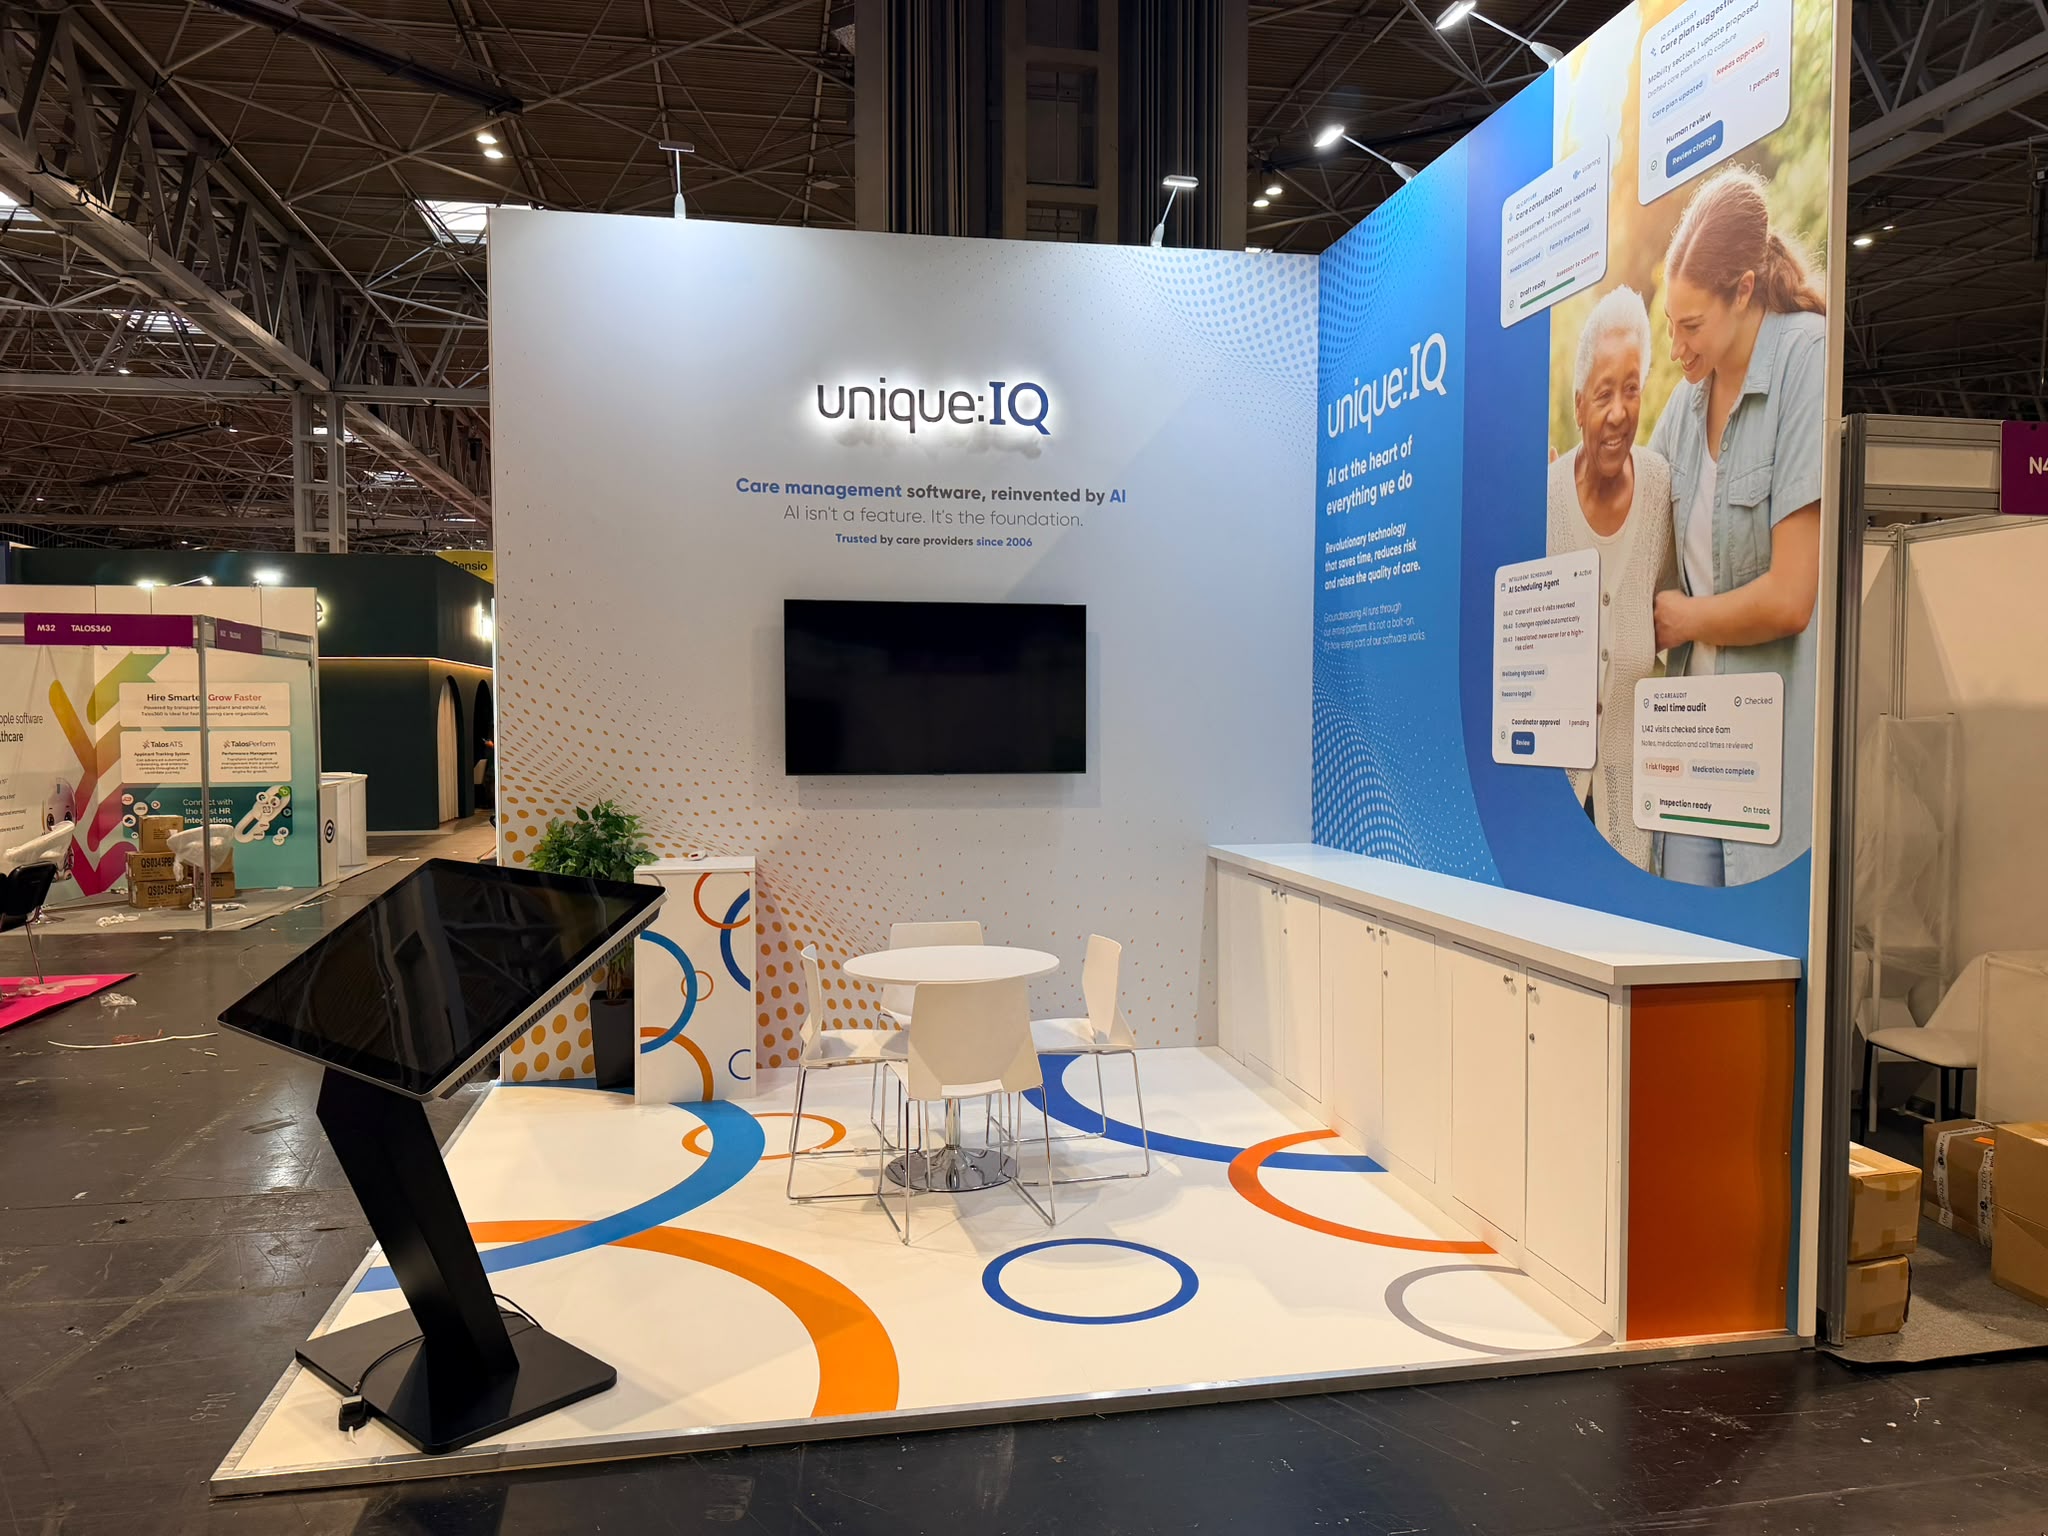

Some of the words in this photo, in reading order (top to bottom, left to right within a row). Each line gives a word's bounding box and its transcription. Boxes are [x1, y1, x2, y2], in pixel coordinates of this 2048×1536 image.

[1648, 64, 1670, 84] Mobility
[1702, 25, 1724, 48] update
[1726, 0, 1758, 31] proposed
[1660, 36, 1678, 54] Care
[1678, 25, 1695, 46] plan
[1680, 65, 1692, 80] plan
[1693, 54, 1706, 68] from
[1714, 33, 1737, 54] capture
[1716, 60, 1735, 76] Needs
[1736, 38, 1765, 65] approval
[1753, 68, 1780, 91] pending
[1652, 106, 1664, 119] Care
[1666, 98, 1678, 113] plan
[1679, 80, 1703, 101] updated
[1666, 126, 1688, 144] Human
[1690, 111, 1712, 130] review
[1672, 150, 1692, 166] Review
[1693, 134, 1716, 152] change
[1516, 207, 1528, 220] Care
[1529, 186, 1563, 215] consultation
[1576, 224, 1590, 237] noted
[1523, 252, 1540, 269] captured
[1519, 287, 1532, 298] Draft
[1532, 280, 1546, 293] ready
[1328, 332, 1447, 438] unique:IQ
[817, 377, 1051, 435] unique:IQ
[1326, 468, 1336, 487] AI
[1338, 465, 1348, 483] at
[1351, 458, 1366, 478] the
[1369, 443, 1398, 470] heart
[1401, 434, 1413, 458] of
[736, 478, 780, 493] Care
[785, 484, 902, 499] management
[907, 485, 986, 502] software,
[992, 487, 1080, 502] reinvented
[1085, 489, 1105, 505] by
[1110, 490, 1126, 503] AI
[1326, 484, 1377, 516] everything
[1379, 478, 1395, 498] we
[1398, 470, 1413, 491] do
[784, 505, 799, 520] AI
[805, 506, 838, 521] isn't
[843, 510, 854, 521] a
[860, 507, 926, 523] feature.
[932, 510, 952, 524] It's
[958, 510, 985, 524] the
[990, 511, 1083, 526] foundation.
[836, 534, 877, 544] Trusted
[880, 535, 893, 546] by
[923, 536, 974, 547] providers
[976, 537, 1003, 546] since
[1006, 537, 1032, 547] 2006
[1325, 534, 1366, 554] Revolutionary
[1368, 522, 1406, 542] technology
[1325, 560, 1337, 572] that
[1338, 556, 1356, 569] saves
[1357, 552, 1372, 565] time,
[1374, 543, 1402, 560] reduces
[1404, 538, 1416, 553] risk
[1325, 577, 1336, 590] and
[1337, 574, 1355, 587] raises
[1356, 571, 1366, 583] the
[1368, 566, 1391, 583] quality
[1393, 561, 1400, 575] of
[1402, 560, 1421, 573] care.
[1515, 582, 1542, 592] Scheduling
[1544, 579, 1560, 590] Agent
[1380, 602, 1401, 614] through
[71, 624, 111, 632] TALOS360
[16, 712, 43, 724] software
[1654, 703, 1668, 712] Real
[1670, 703, 1685, 712] time
[1686, 703, 1706, 712] audit
[1539, 719, 1560, 727] approval
[1671, 725, 1696, 734] checked
[0, 730, 23, 742] thcare
[1692, 765, 1724, 774] Medication
[1725, 767, 1754, 776] complete
[1660, 798, 1692, 809] Inspection
[1693, 801, 1712, 811] ready
[1753, 806, 1770, 815] track
